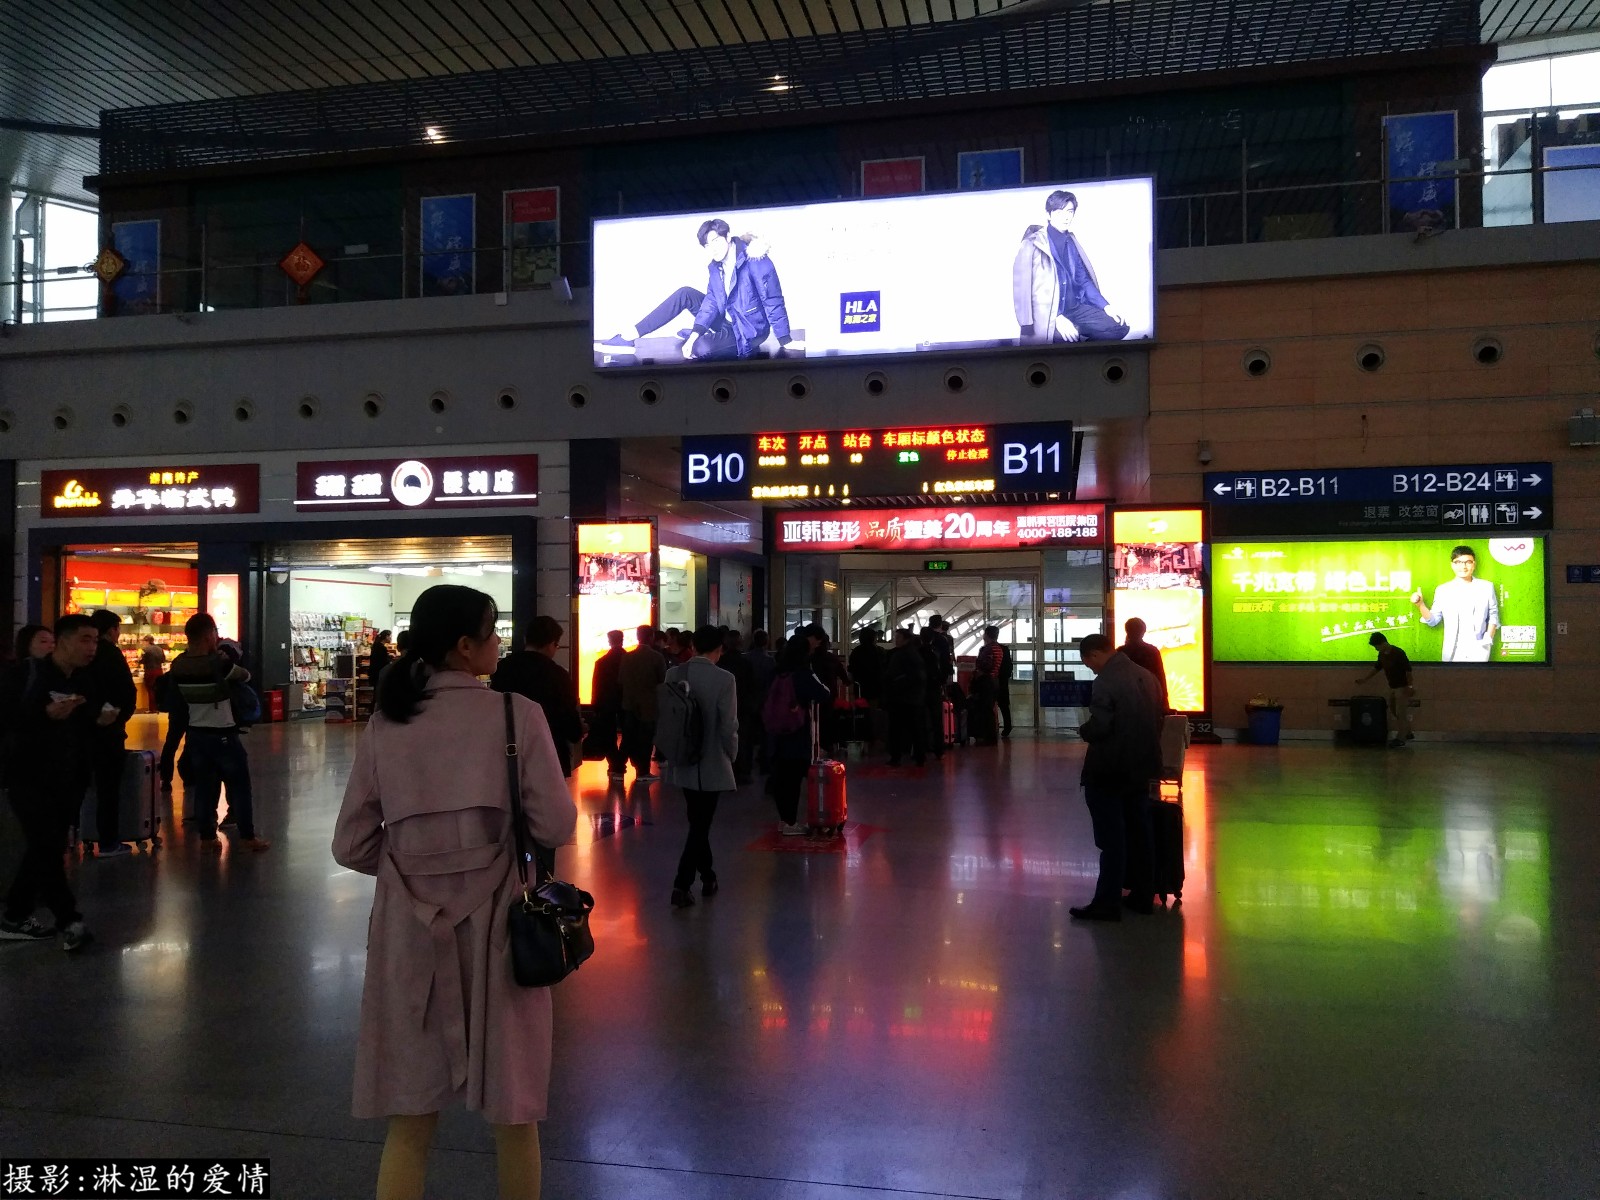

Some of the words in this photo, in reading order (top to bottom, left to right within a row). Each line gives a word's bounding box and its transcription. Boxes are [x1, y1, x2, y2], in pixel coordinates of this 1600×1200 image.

[845, 299, 878, 314] HLA
[758, 436, 786, 451] 车次
[799, 434, 827, 450] 开点
[843, 433, 872, 448] 站台
[883, 428, 985, 447] 车厢标颜色状态
[946, 448, 989, 461] 停止检票
[1003, 441, 1060, 474] B11
[688, 452, 745, 484] B10
[1261, 476, 1339, 497] B2-B11
[1393, 472, 1491, 493] B12-B24
[1363, 505, 1391, 519] 退票
[782, 520, 861, 543] 亚韩整形
[1016, 527, 1098, 539] 4000-188-188
[1232, 570, 1316, 593] 千兆宽带
[1324, 569, 1412, 593] 绿色上网
